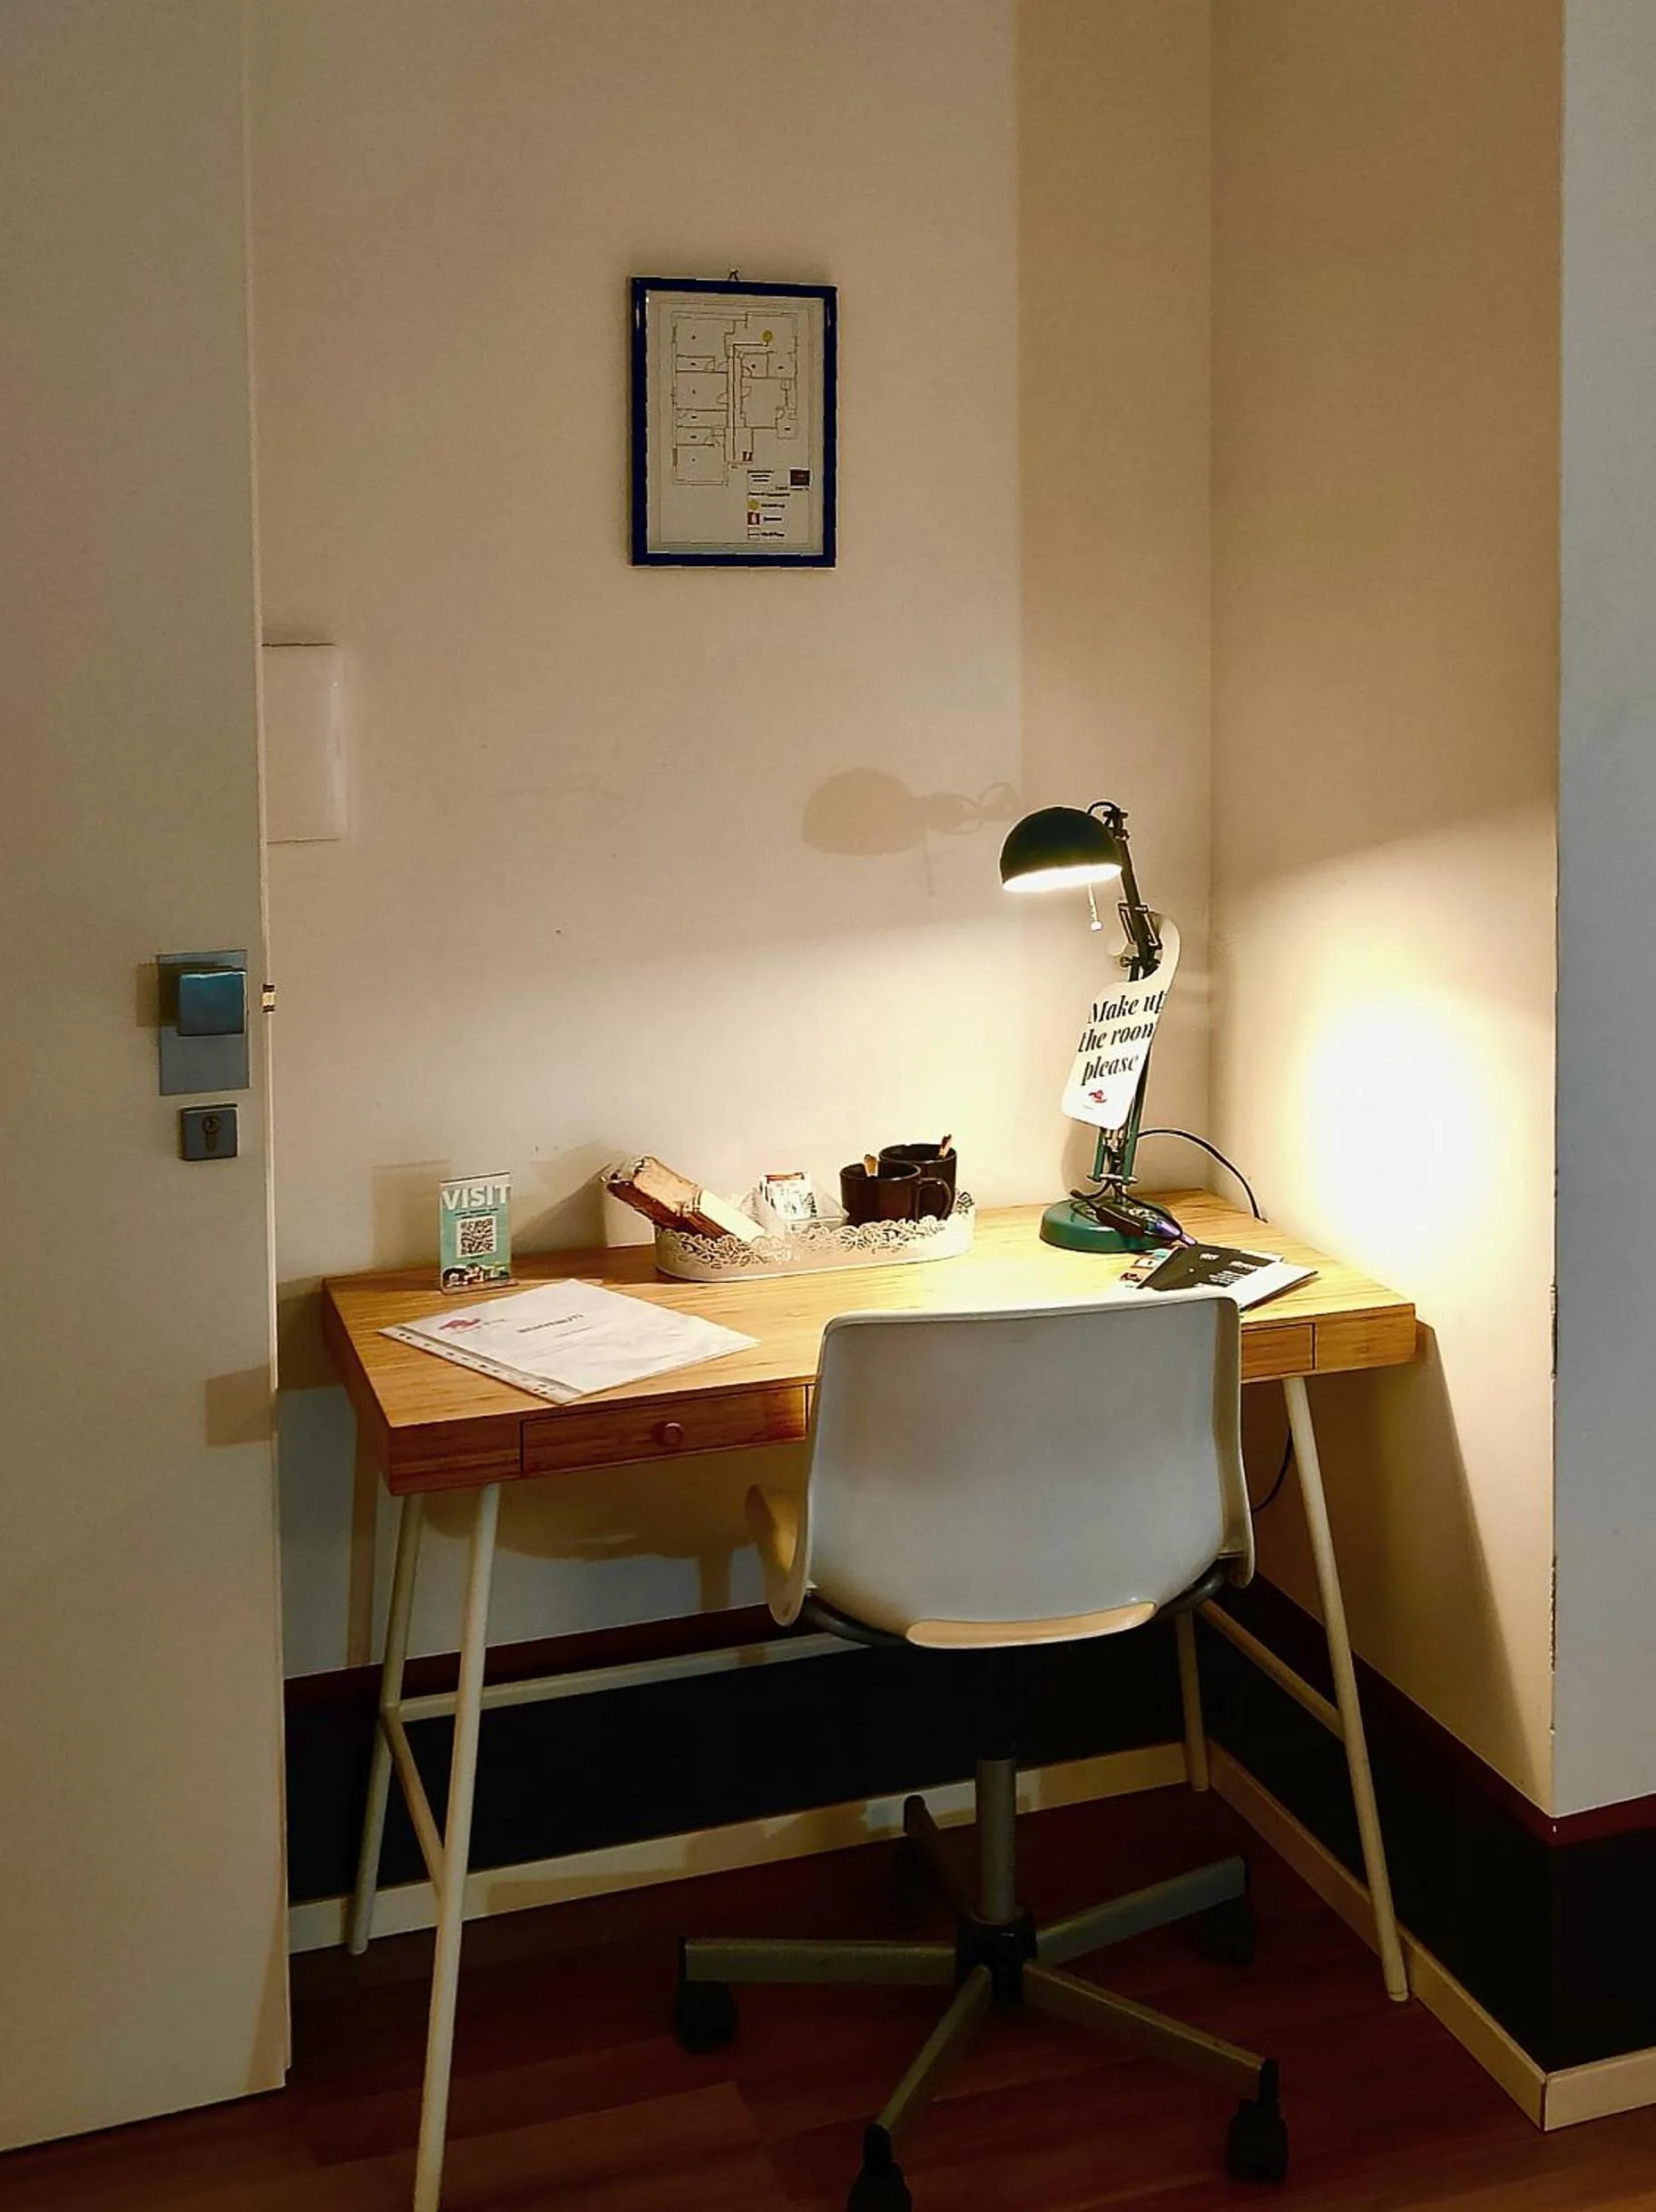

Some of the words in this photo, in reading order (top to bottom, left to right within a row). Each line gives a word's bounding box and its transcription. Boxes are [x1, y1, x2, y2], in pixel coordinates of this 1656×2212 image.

[1087, 994, 1140, 1024] Make
[1077, 1028, 1108, 1052] the
[1081, 1056, 1139, 1086] please
[441, 1184, 510, 1210] VISIT
